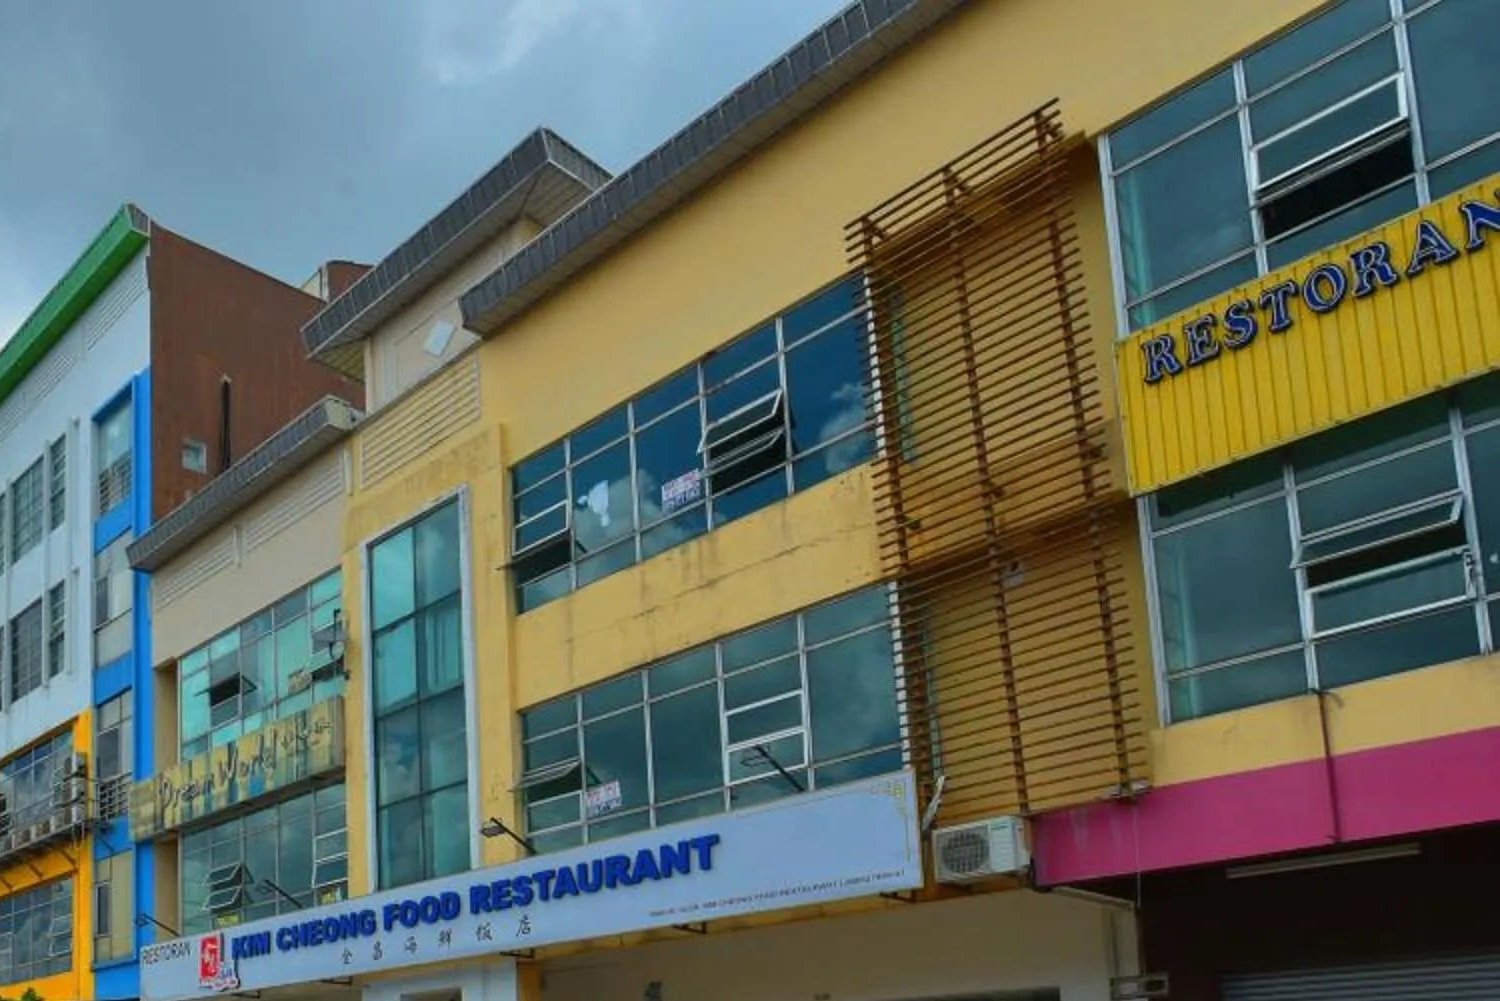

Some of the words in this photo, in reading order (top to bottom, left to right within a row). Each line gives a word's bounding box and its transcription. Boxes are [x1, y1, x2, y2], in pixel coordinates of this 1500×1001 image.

[1140, 188, 1500, 386] RESTORAN
[142, 940, 192, 966] RESTORAN
[231, 931, 271, 961] KIM
[276, 909, 378, 952] CHEONG
[383, 891, 462, 932] FOOD
[469, 833, 721, 915] RESTAURANT
